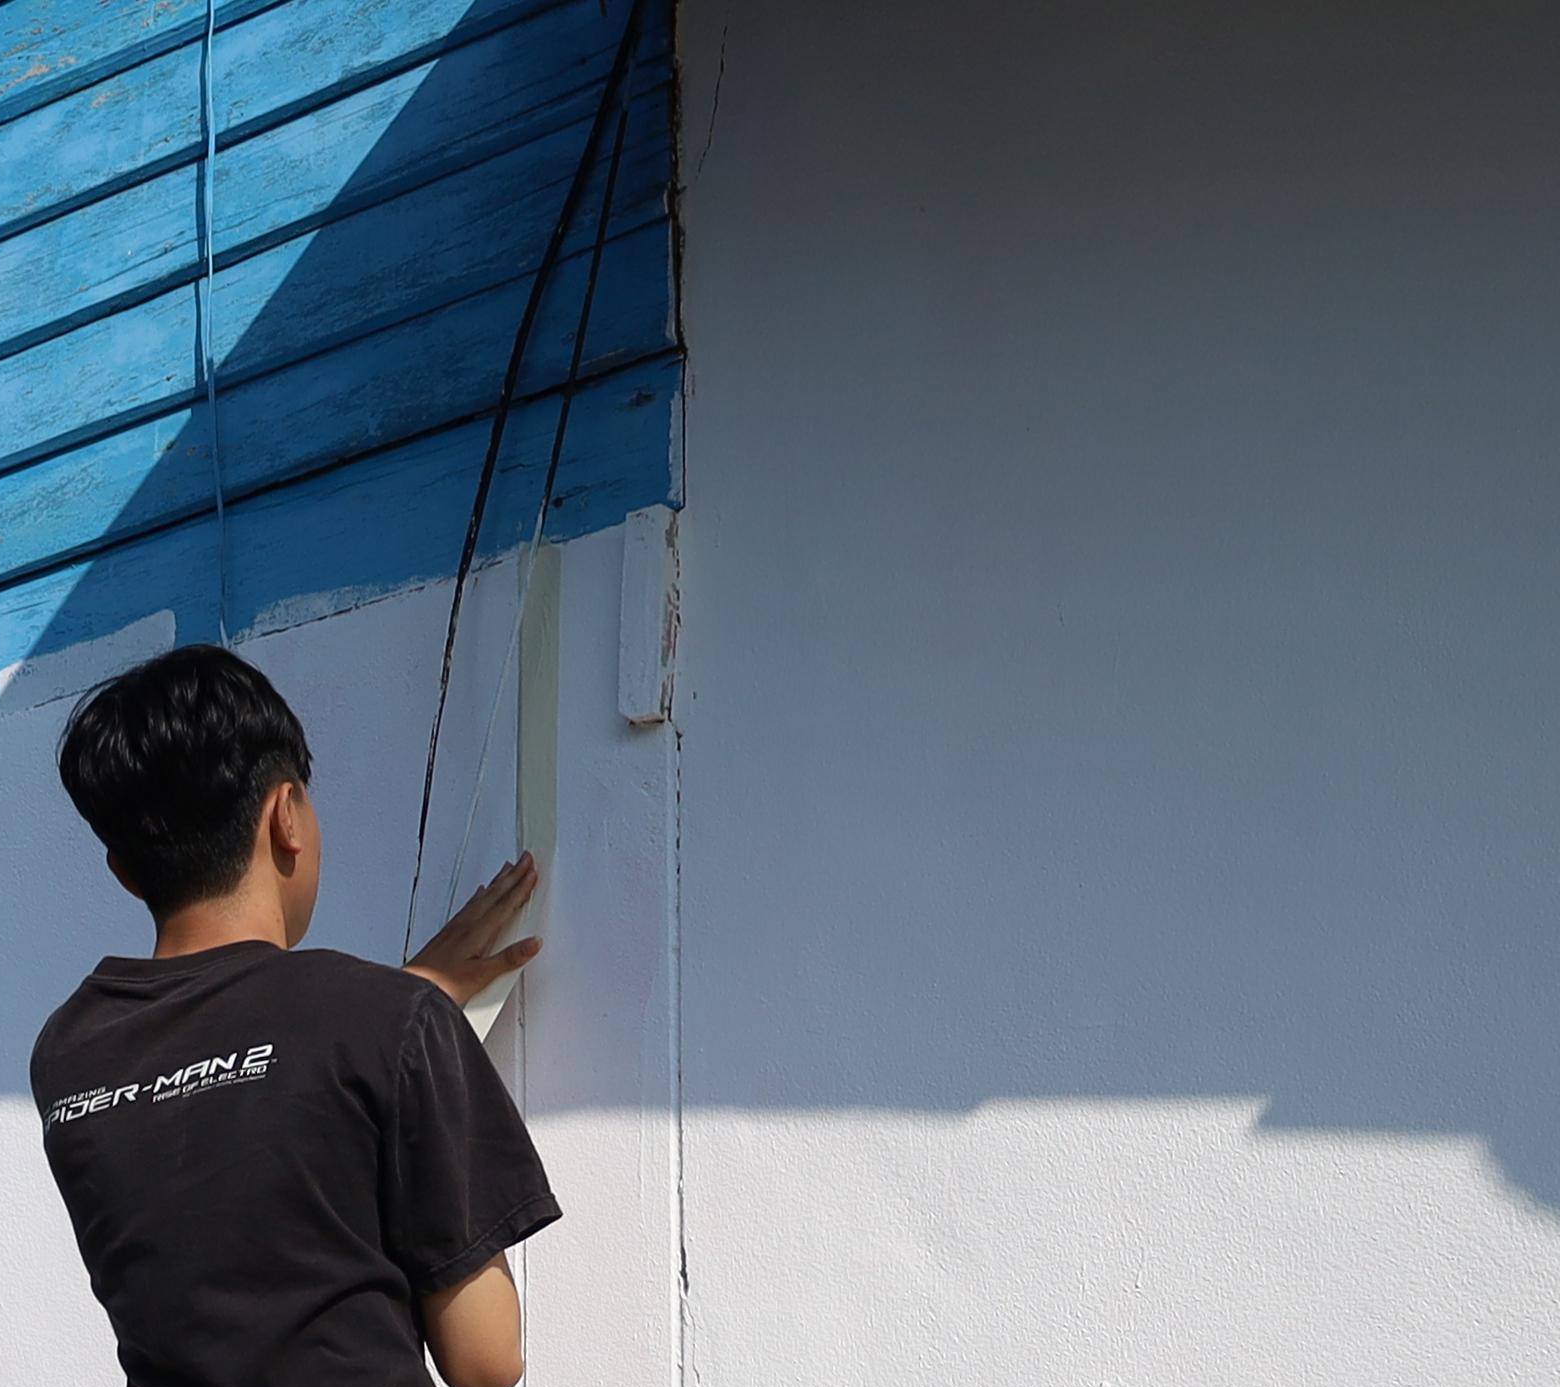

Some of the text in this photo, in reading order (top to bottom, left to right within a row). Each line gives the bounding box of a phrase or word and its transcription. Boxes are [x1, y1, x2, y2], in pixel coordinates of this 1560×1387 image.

[45, 1052, 238, 1134] PIDER-MAN
[242, 1044, 273, 1069] 2
[153, 1087, 181, 1104] RISE
[182, 1080, 200, 1094] OF
[200, 1064, 268, 1087] ELECTRO
